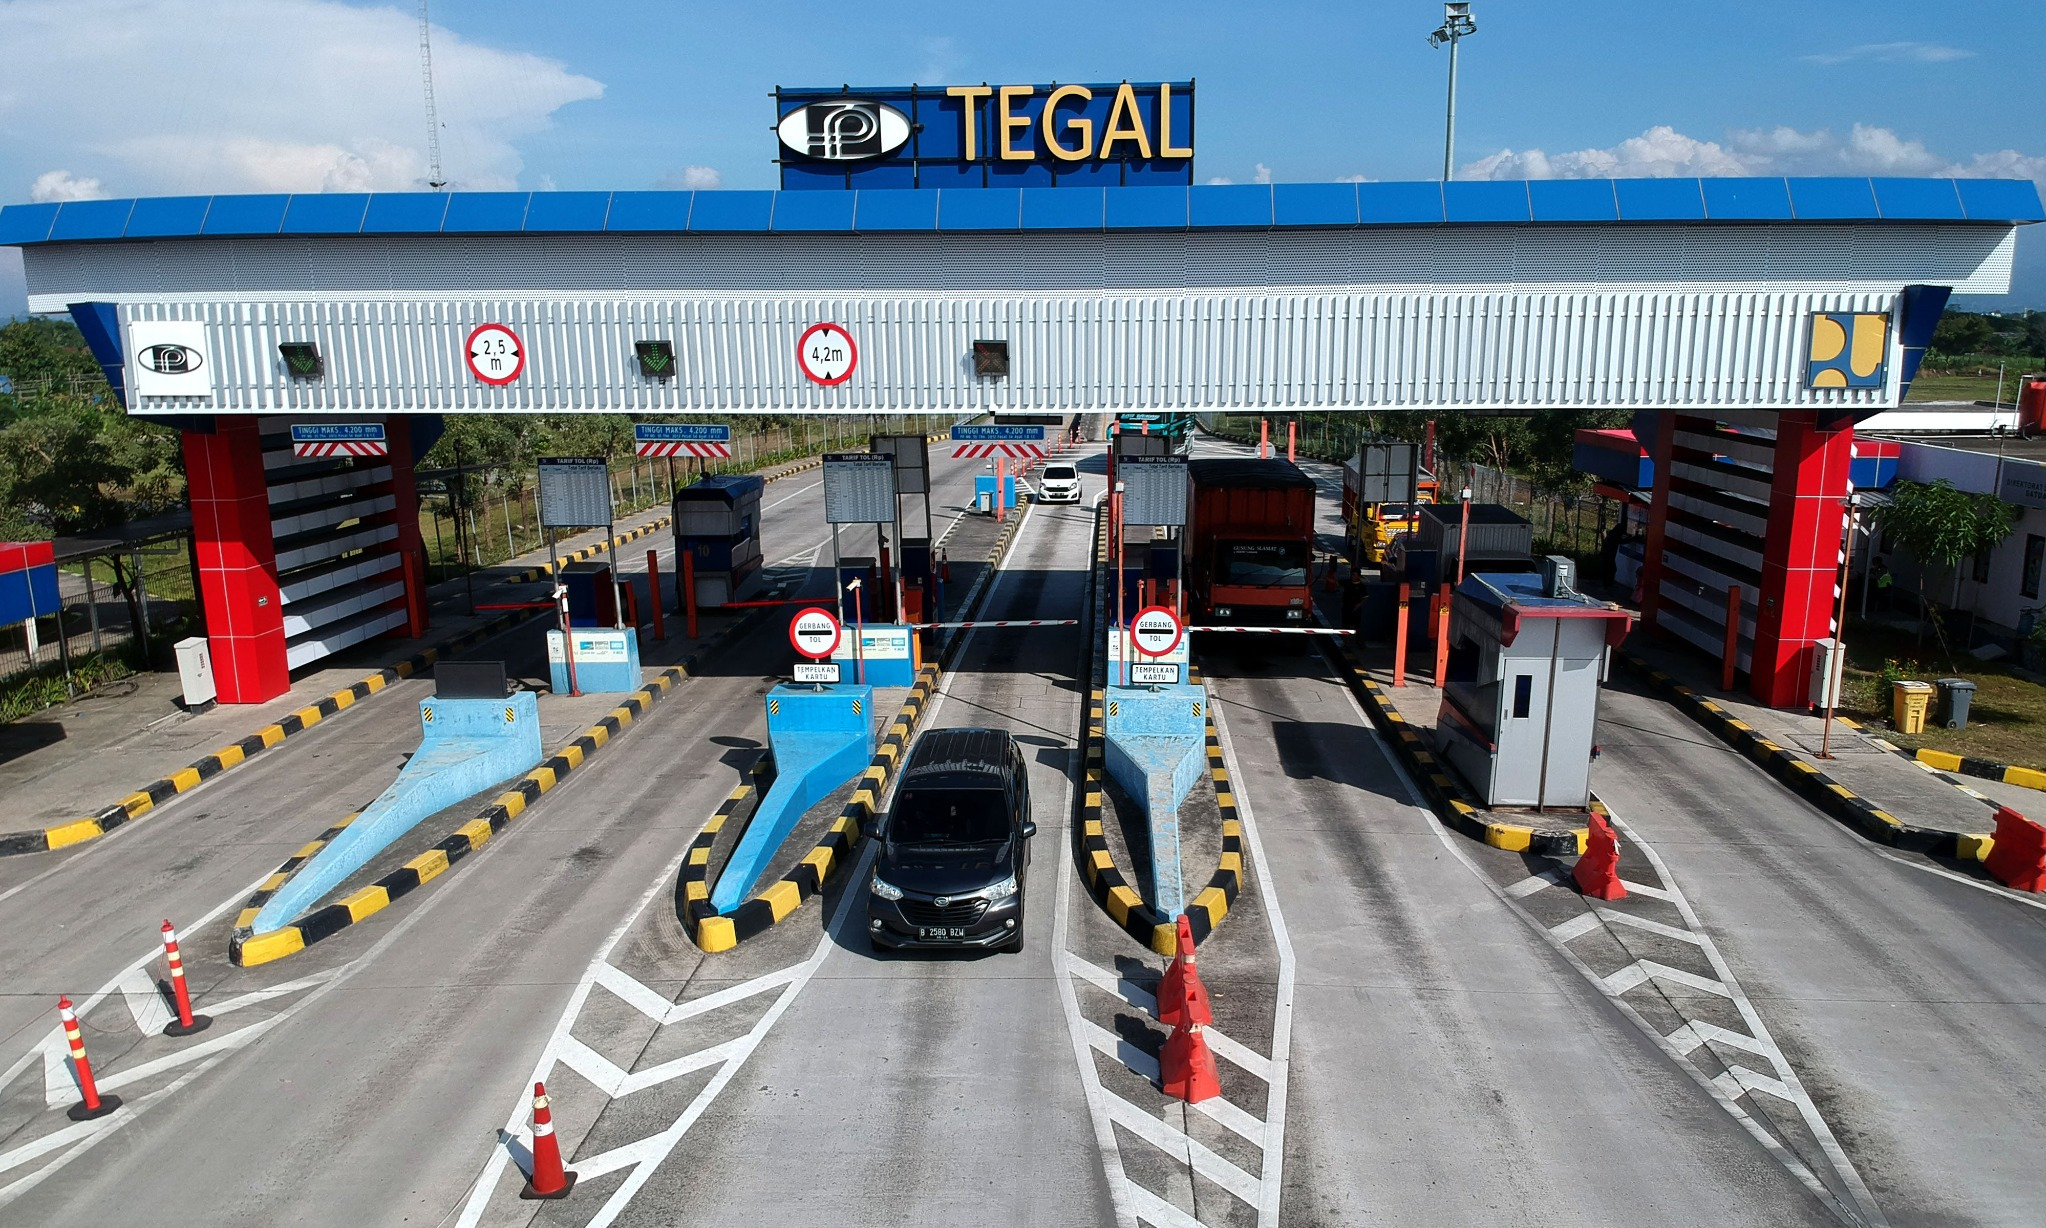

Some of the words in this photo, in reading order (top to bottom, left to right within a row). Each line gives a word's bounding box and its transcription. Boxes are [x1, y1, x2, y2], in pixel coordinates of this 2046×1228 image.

[946, 83, 1192, 160] TEGAL
[483, 340, 506, 357] 2,5
[812, 346, 843, 364] 4,2m
[490, 358, 502, 370] m
[950, 928, 964, 936] BZW
